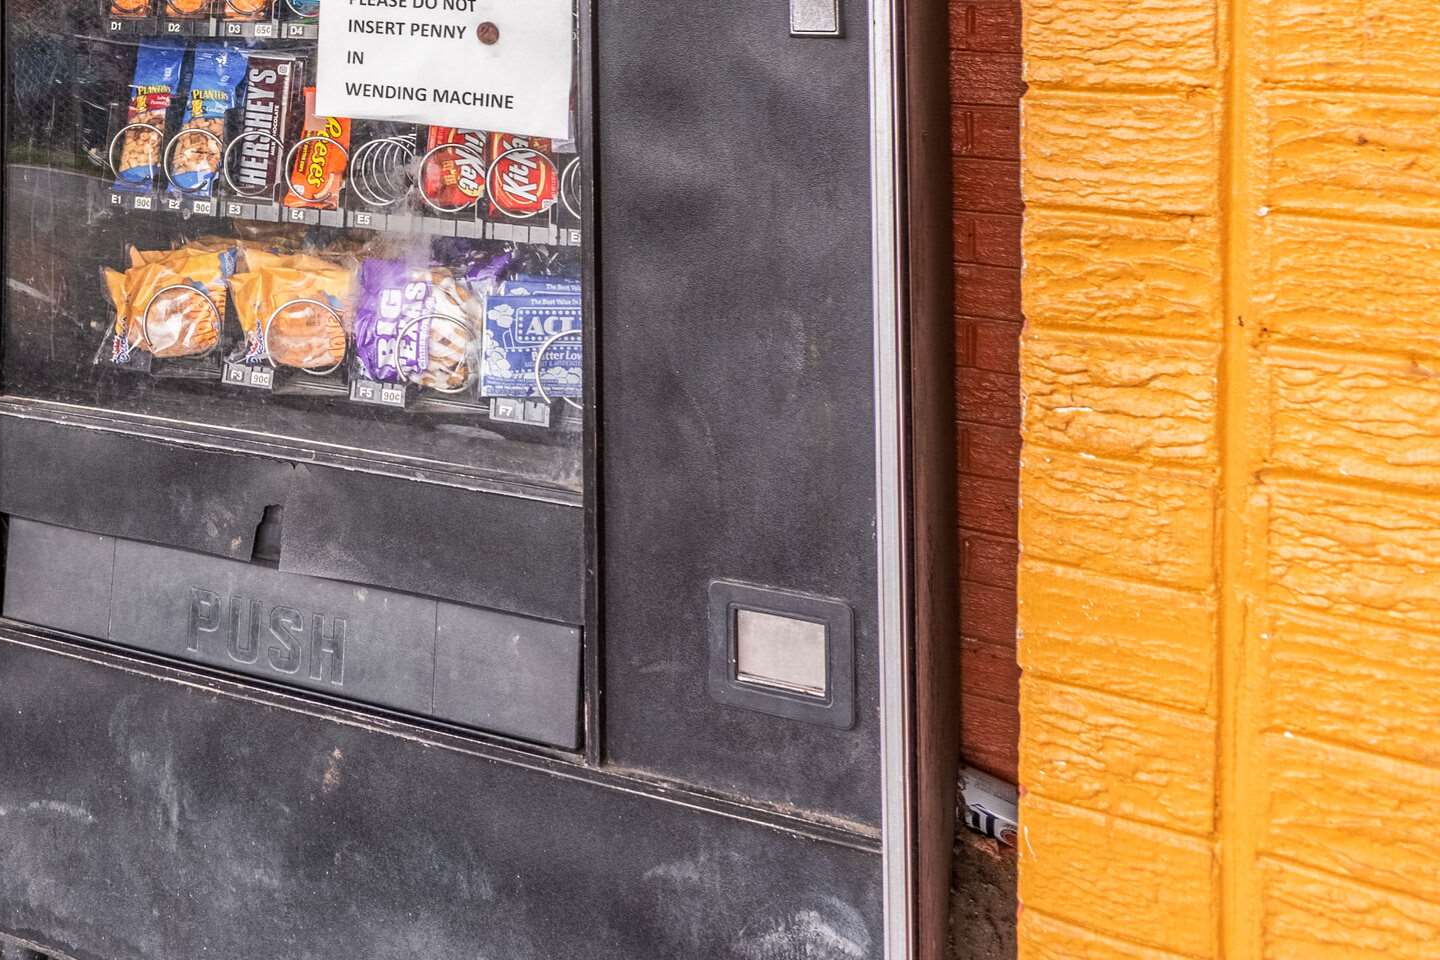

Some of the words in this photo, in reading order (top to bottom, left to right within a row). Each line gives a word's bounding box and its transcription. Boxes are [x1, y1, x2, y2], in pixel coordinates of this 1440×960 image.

[111, 22, 122, 31] D1
[168, 24, 181, 33] D2
[228, 24, 241, 33] D3
[290, 26, 303, 35] D4
[348, 19, 406, 36] INSERT
[410, 23, 467, 39] PENNY
[347, 50, 364, 65] IN
[345, 82, 427, 102] WENDING
[432, 88, 514, 110] MACHINE
[240, 68, 277, 186] HERSHEY'S
[307, 117, 342, 188] Reese's
[111, 195, 122, 204] E1
[136, 198, 151, 208] 90¢
[168, 199, 180, 209] E2
[195, 202, 210, 213] 90¢
[229, 205, 241, 214] E3
[291, 211, 304, 220] E4
[356, 215, 371, 225] E5
[376, 289, 402, 369] BIG
[526, 316, 575, 335] ACT
[532, 351, 564, 360] Btter
[253, 373, 268, 384] 90¢
[360, 388, 374, 397] F5
[383, 391, 401, 401] 90¢
[499, 406, 513, 417] F7
[186, 587, 347, 686] PUSH
